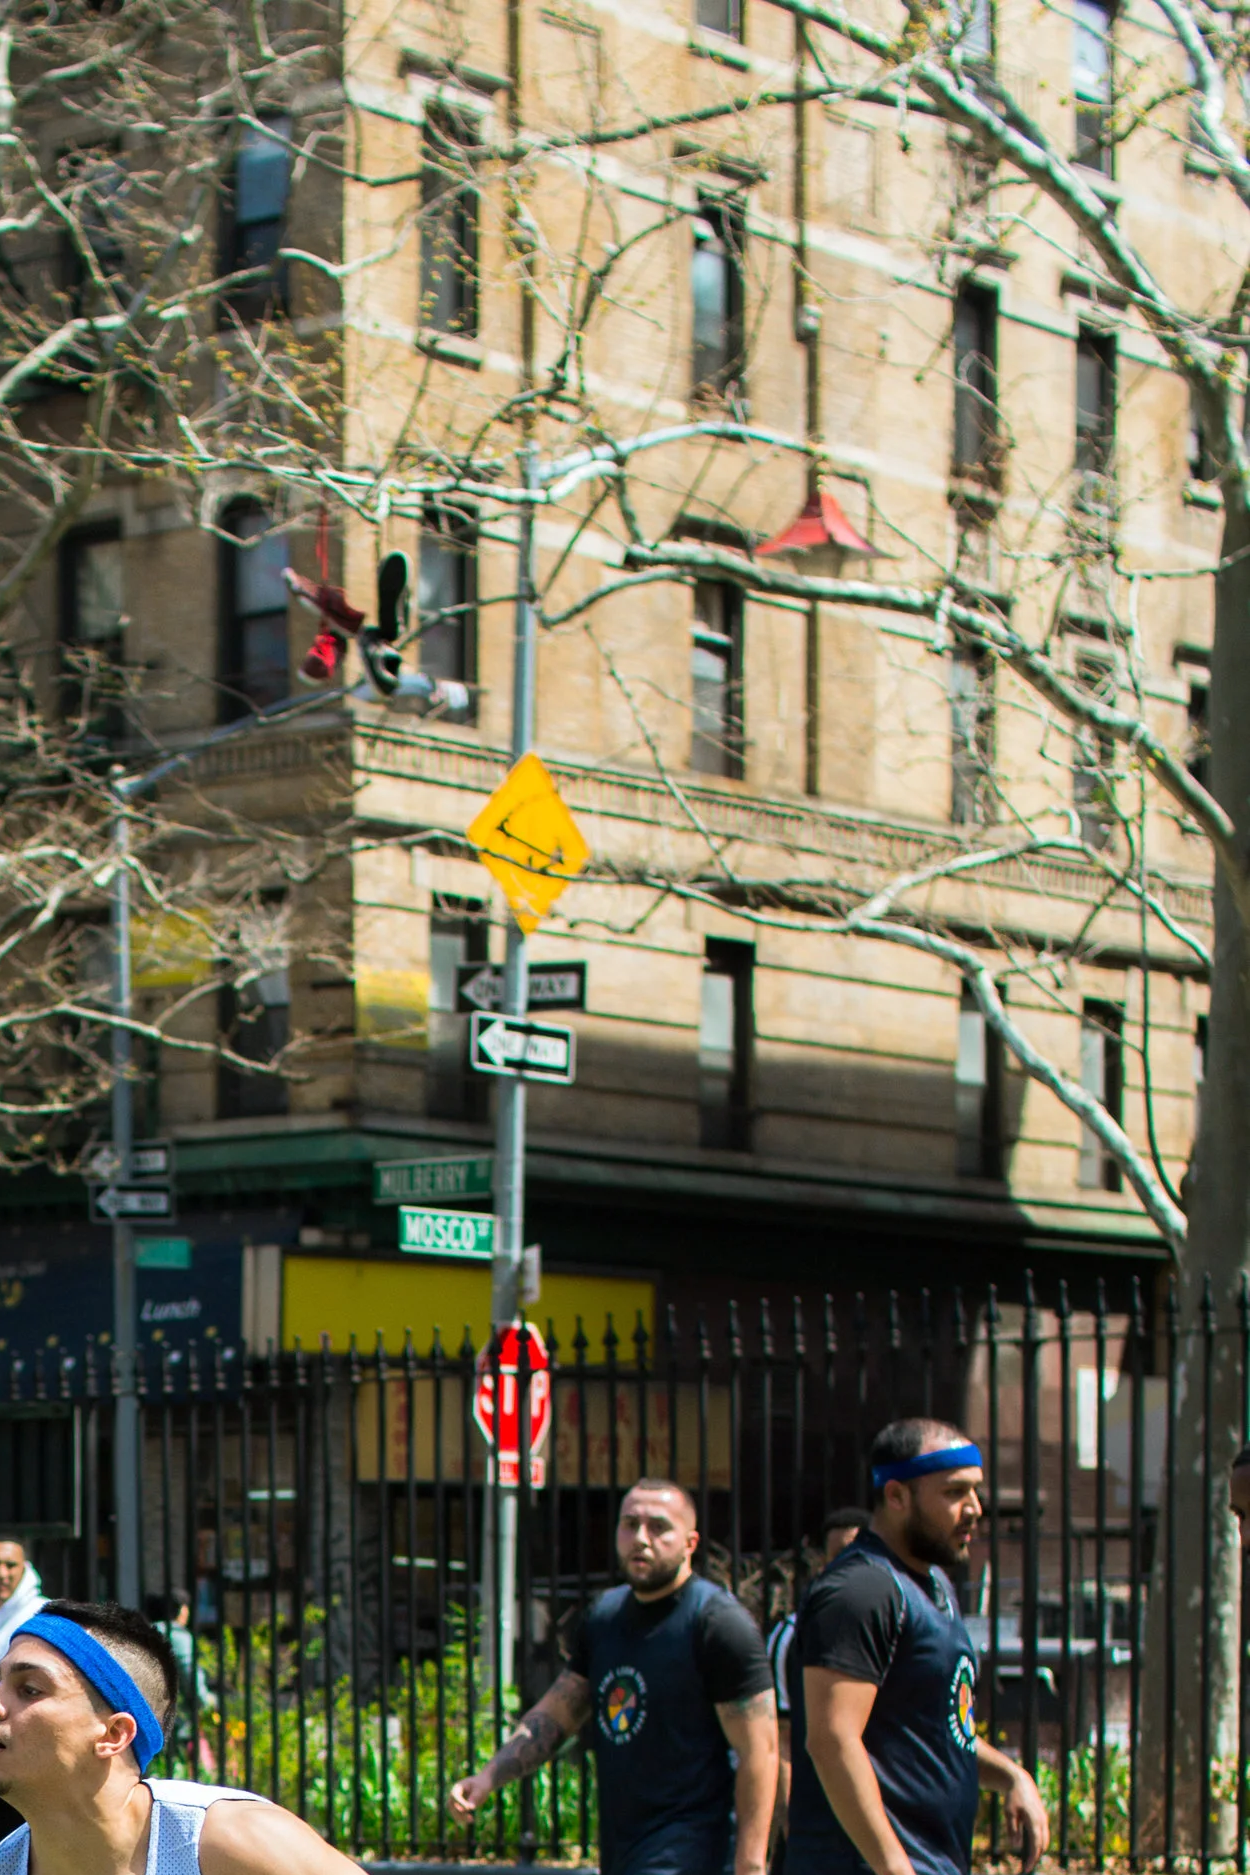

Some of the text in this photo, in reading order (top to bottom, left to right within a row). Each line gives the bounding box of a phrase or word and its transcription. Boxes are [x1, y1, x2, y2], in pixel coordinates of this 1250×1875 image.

[379, 1164, 468, 1197] MULBERRY
[405, 1213, 476, 1251] MOSCO
[140, 1296, 202, 1322] Lunch
